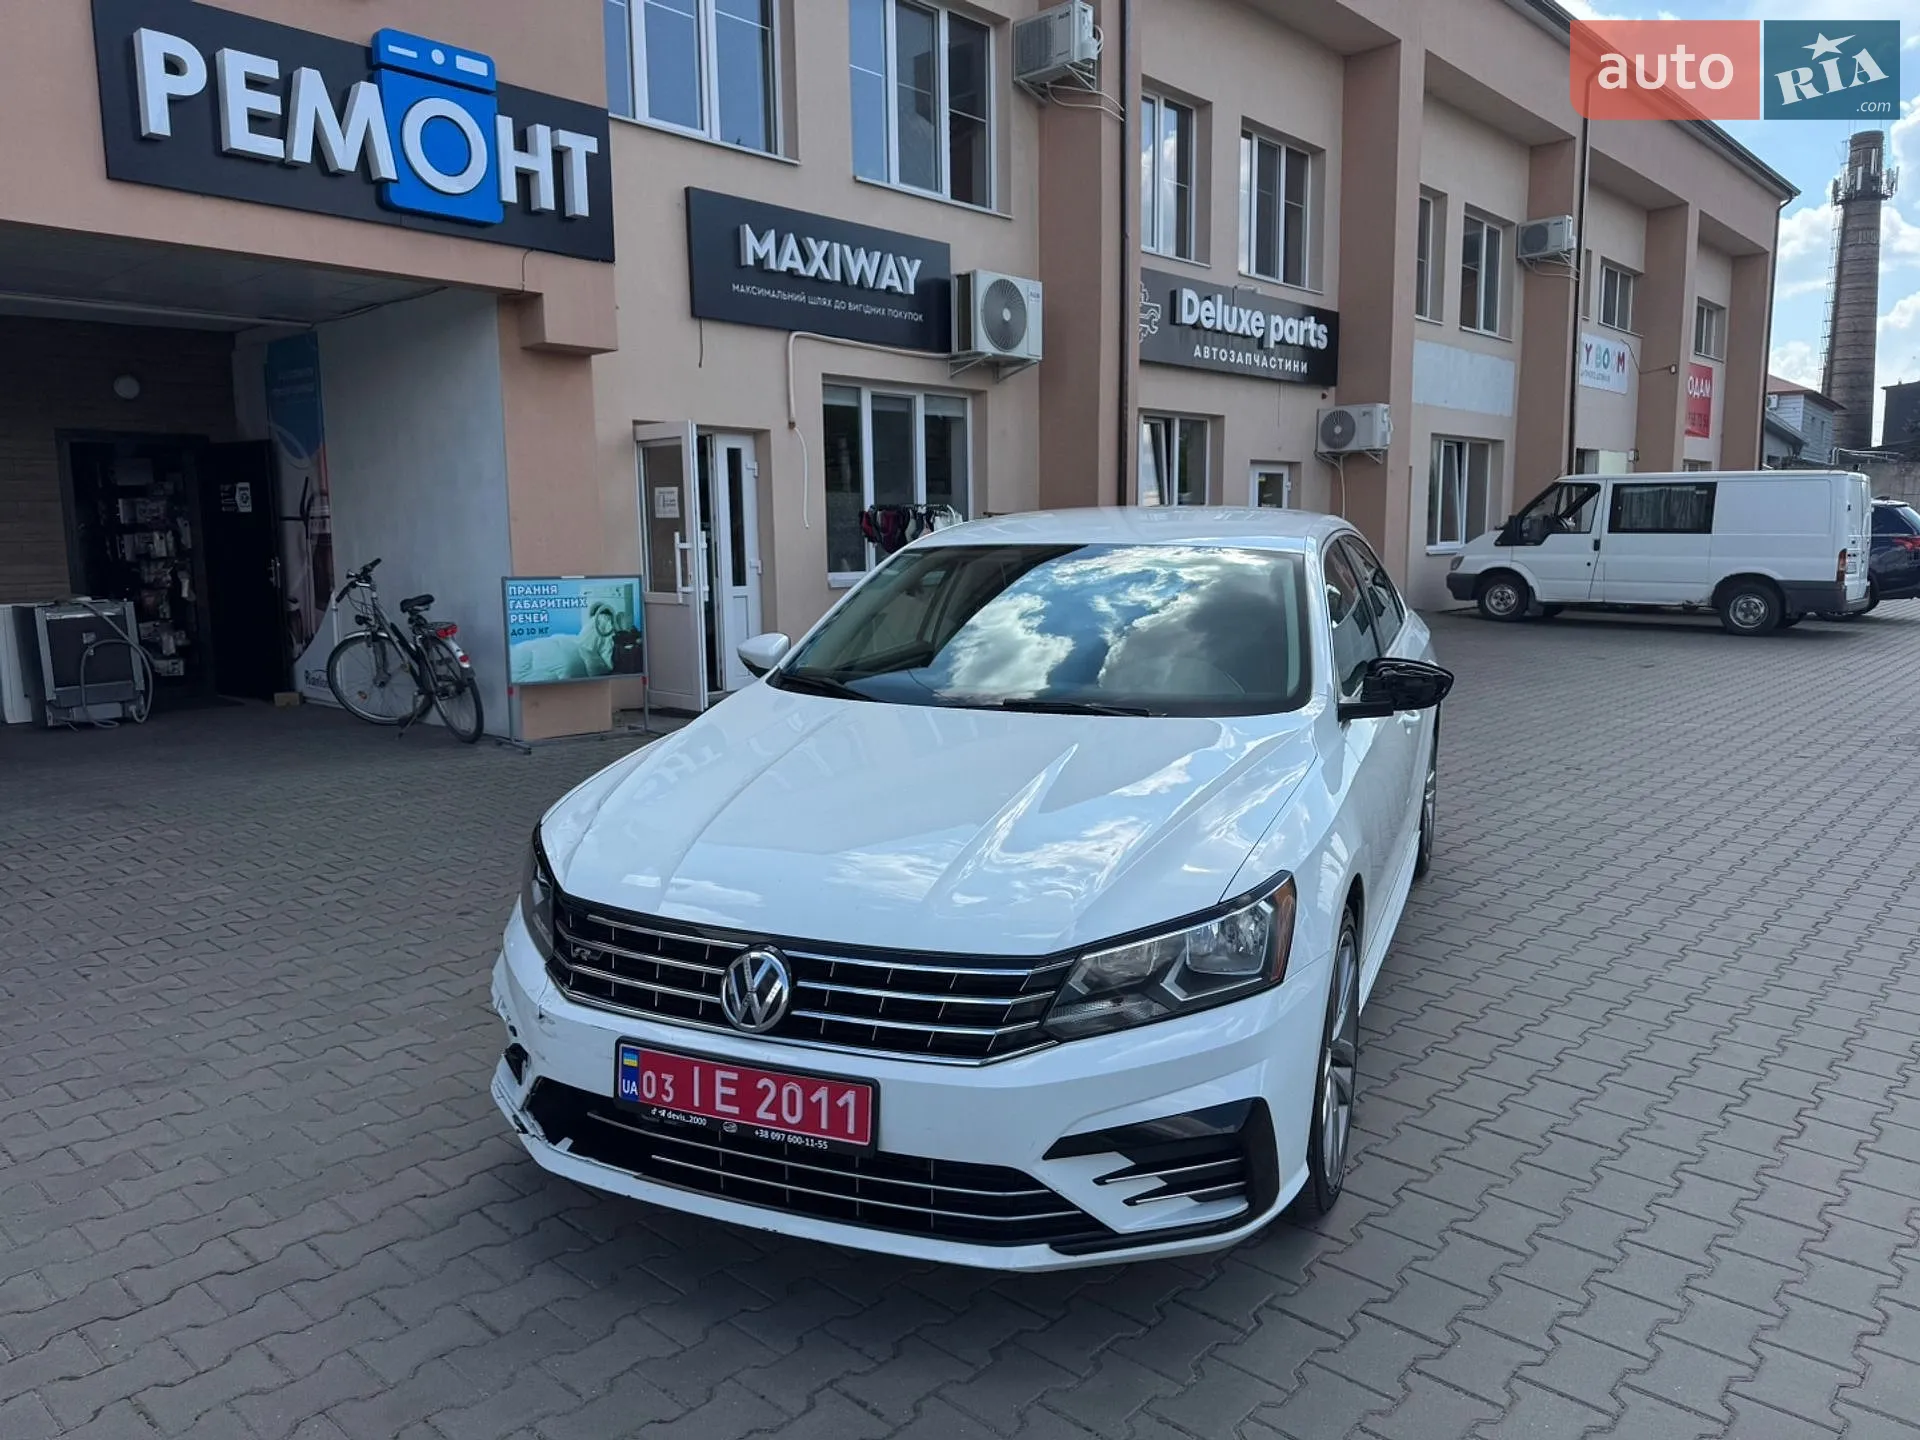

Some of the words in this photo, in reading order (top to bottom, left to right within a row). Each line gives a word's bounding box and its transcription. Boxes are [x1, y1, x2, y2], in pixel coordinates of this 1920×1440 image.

[133, 27, 598, 219] РЕМОНТ
[739, 223, 922, 295] MAXIWAY
[731, 283, 806, 303] МАКСИМАЛЬНИЙ
[807, 295, 833, 308] ШЛЯХ
[834, 300, 847, 312] ДО
[887, 308, 924, 322] ПОКУПОК
[1179, 287, 1265, 338] Deluxe
[1270, 313, 1329, 350] parts
[1193, 344, 1308, 374] АВТОЗАПЧАСТИНИ
[509, 584, 558, 595] ПРАННЯ
[509, 599, 586, 609] ГАБАРИТНИХ
[510, 611, 549, 624] РЕЧЕЙ
[511, 628, 523, 637] ДО
[622, 1078, 639, 1096] UA
[642, 1071, 675, 1103] 03
[756, 1078, 857, 1135] 2011
